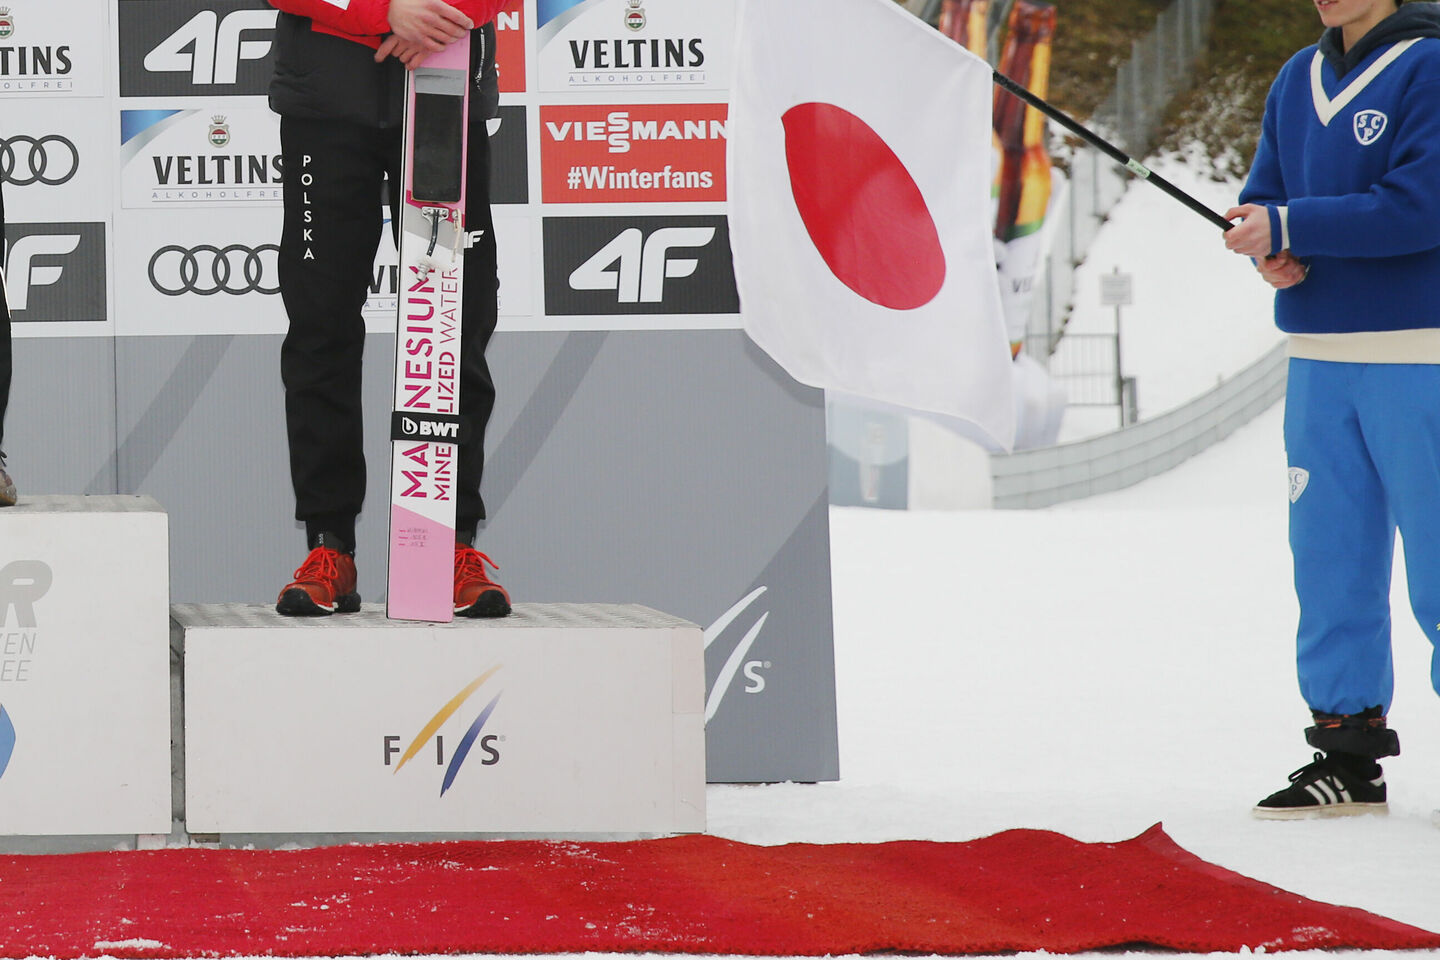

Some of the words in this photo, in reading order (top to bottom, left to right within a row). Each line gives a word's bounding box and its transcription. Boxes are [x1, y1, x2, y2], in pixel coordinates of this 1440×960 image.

[143, 9, 279, 85] 4F
[569, 38, 705, 68] VELTINS
[4, 81, 73, 89] OLFREI
[568, 74, 706, 83] ALKOHOLFREI
[545, 112, 728, 154] VIESSMANN
[152, 155, 284, 186] VELTINS
[568, 165, 713, 191] #Winterfans
[152, 190, 281, 201] ALKOHOLFRE
[302, 154, 315, 261] POLSKA
[569, 227, 716, 304] 4F
[439, 266, 458, 344] WATER
[400, 266, 435, 499] MANESIUM
[419, 420, 459, 438] BWT
[433, 351, 456, 501] MINELIZED
[384, 734, 501, 767] FIS
